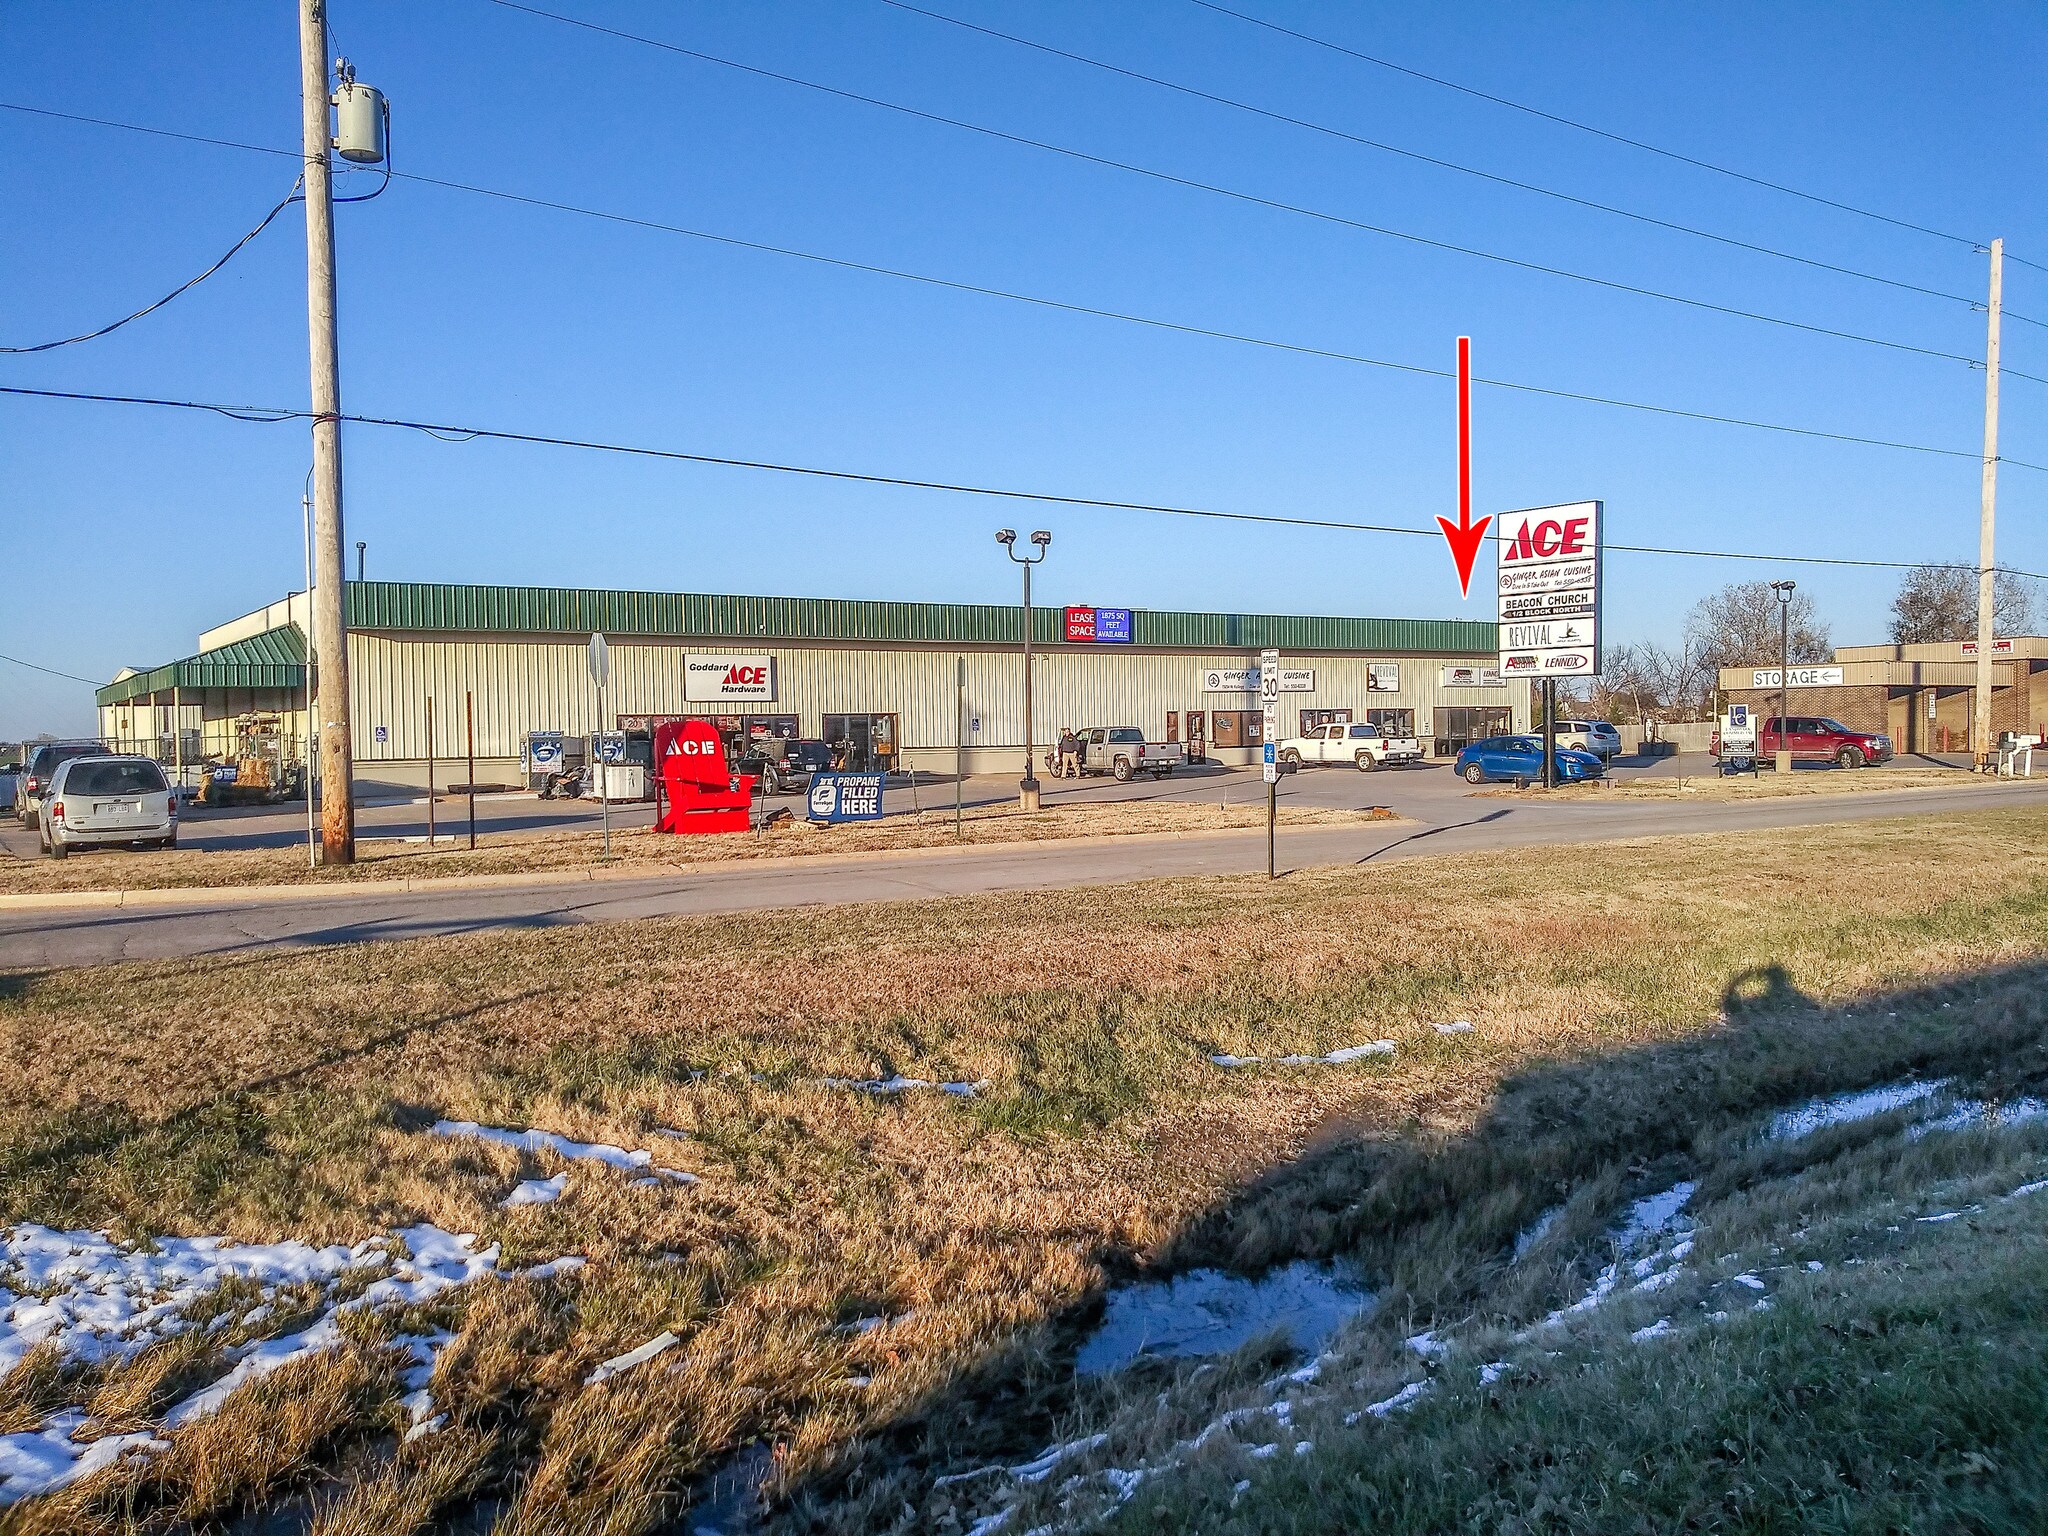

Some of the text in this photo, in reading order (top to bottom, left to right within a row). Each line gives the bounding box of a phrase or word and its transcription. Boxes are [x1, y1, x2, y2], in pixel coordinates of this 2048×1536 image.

[1504, 517, 1589, 561] ACE
[1512, 565, 1591, 582] GINGER ASIAN CUISINE
[1506, 593, 1588, 609] BEACON CHURCH
[1553, 605, 1580, 613] NORTH
[1070, 613, 1095, 622] LEASE
[1116, 612, 1125, 621] SQ
[1069, 626, 1095, 636] SPACE
[1509, 625, 1551, 647] REVIVAL
[689, 663, 729, 671] Goddard
[1545, 657, 1579, 668] LENNOX
[722, 663, 767, 685] ACE
[1223, 672, 1251, 681] GINGER
[1283, 671, 1310, 680] CUISINE
[1755, 671, 1818, 685] STORAGE
[721, 685, 766, 693] Hardware
[1263, 678, 1277, 696] 30
[666, 737, 715, 756] ACE
[837, 777, 880, 787] PROPANE
[842, 787, 878, 799] FILLED
[841, 799, 877, 815] HERE
